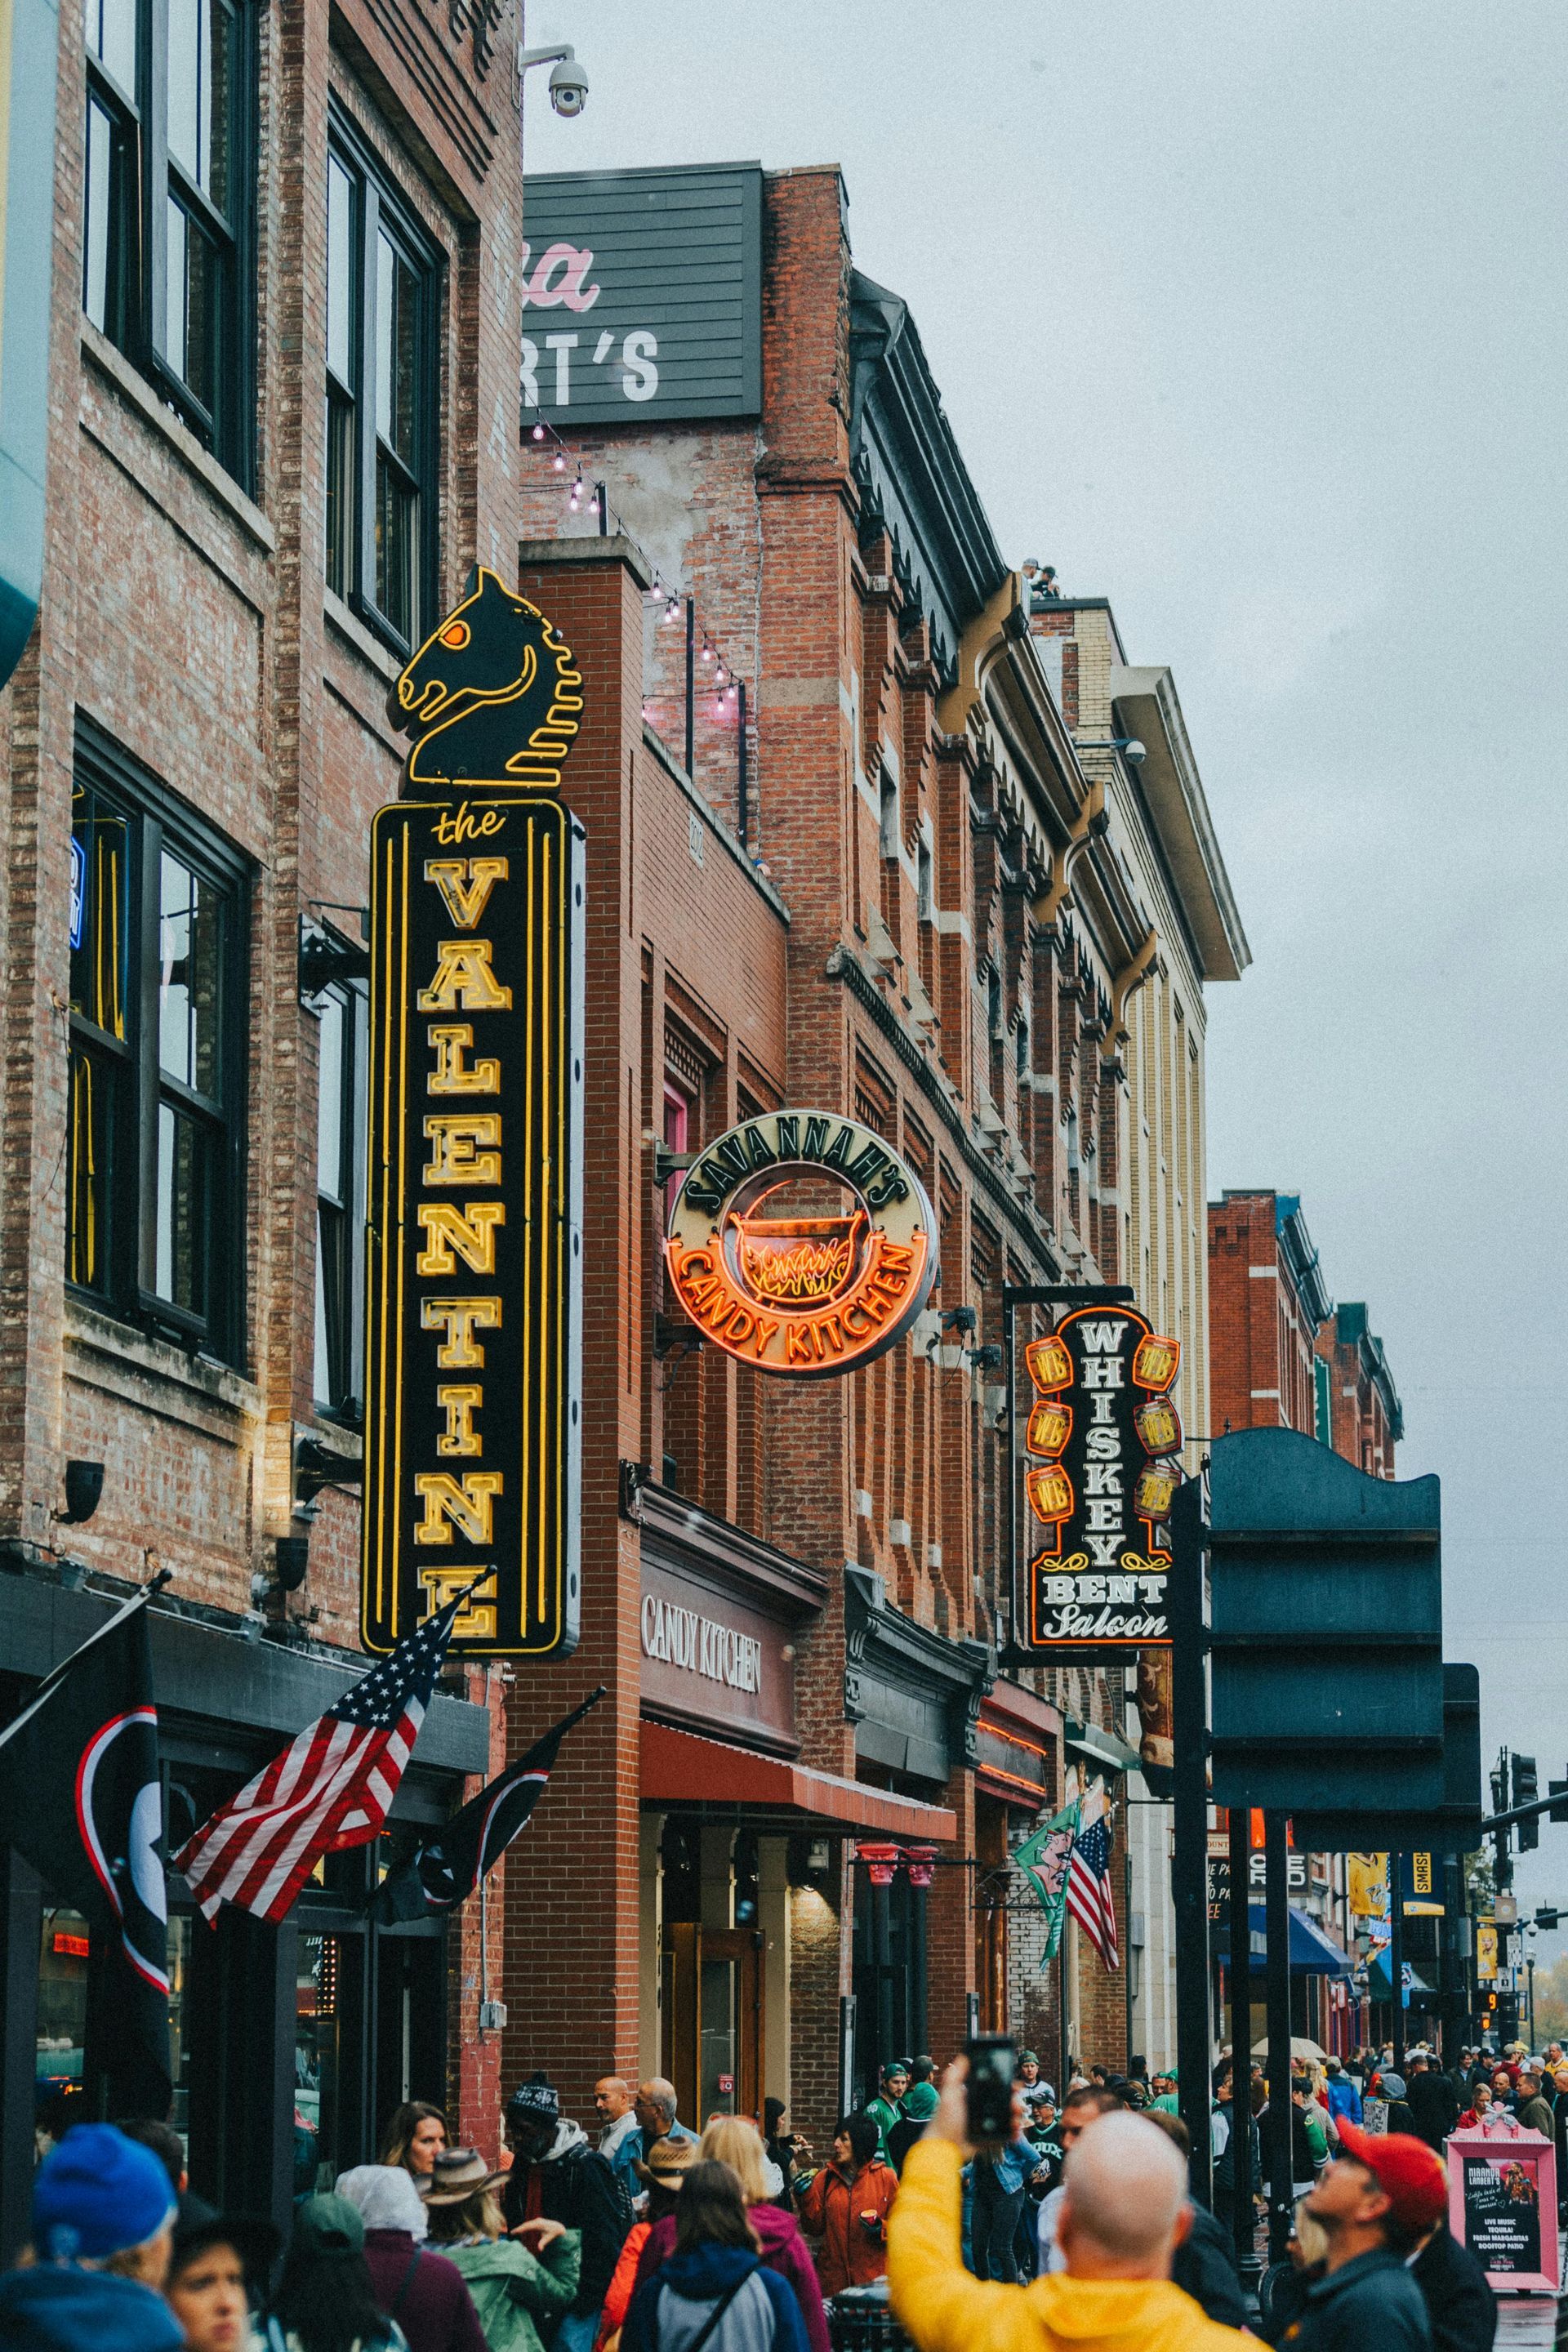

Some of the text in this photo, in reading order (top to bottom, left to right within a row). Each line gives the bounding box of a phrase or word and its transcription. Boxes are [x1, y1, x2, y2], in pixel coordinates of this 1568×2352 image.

[522, 242, 600, 313] a
[431, 801, 508, 845] the
[684, 1115, 910, 1217] SAVANNAH'S
[414, 856, 513, 1639] VALENTINE
[679, 1243, 915, 1365] CANDY KITCHEN
[1076, 1320, 1129, 1567] WHISKEY
[1042, 1575, 1168, 1605] BENT
[641, 1594, 761, 1695] CANDY KITCHEN
[1043, 1603, 1168, 1639] Saloon
[1489, 1993, 1496, 2010] 9
[1468, 2167, 1500, 2177] MIRANDA
[1469, 2177, 1501, 2185] LAMBERT'S
